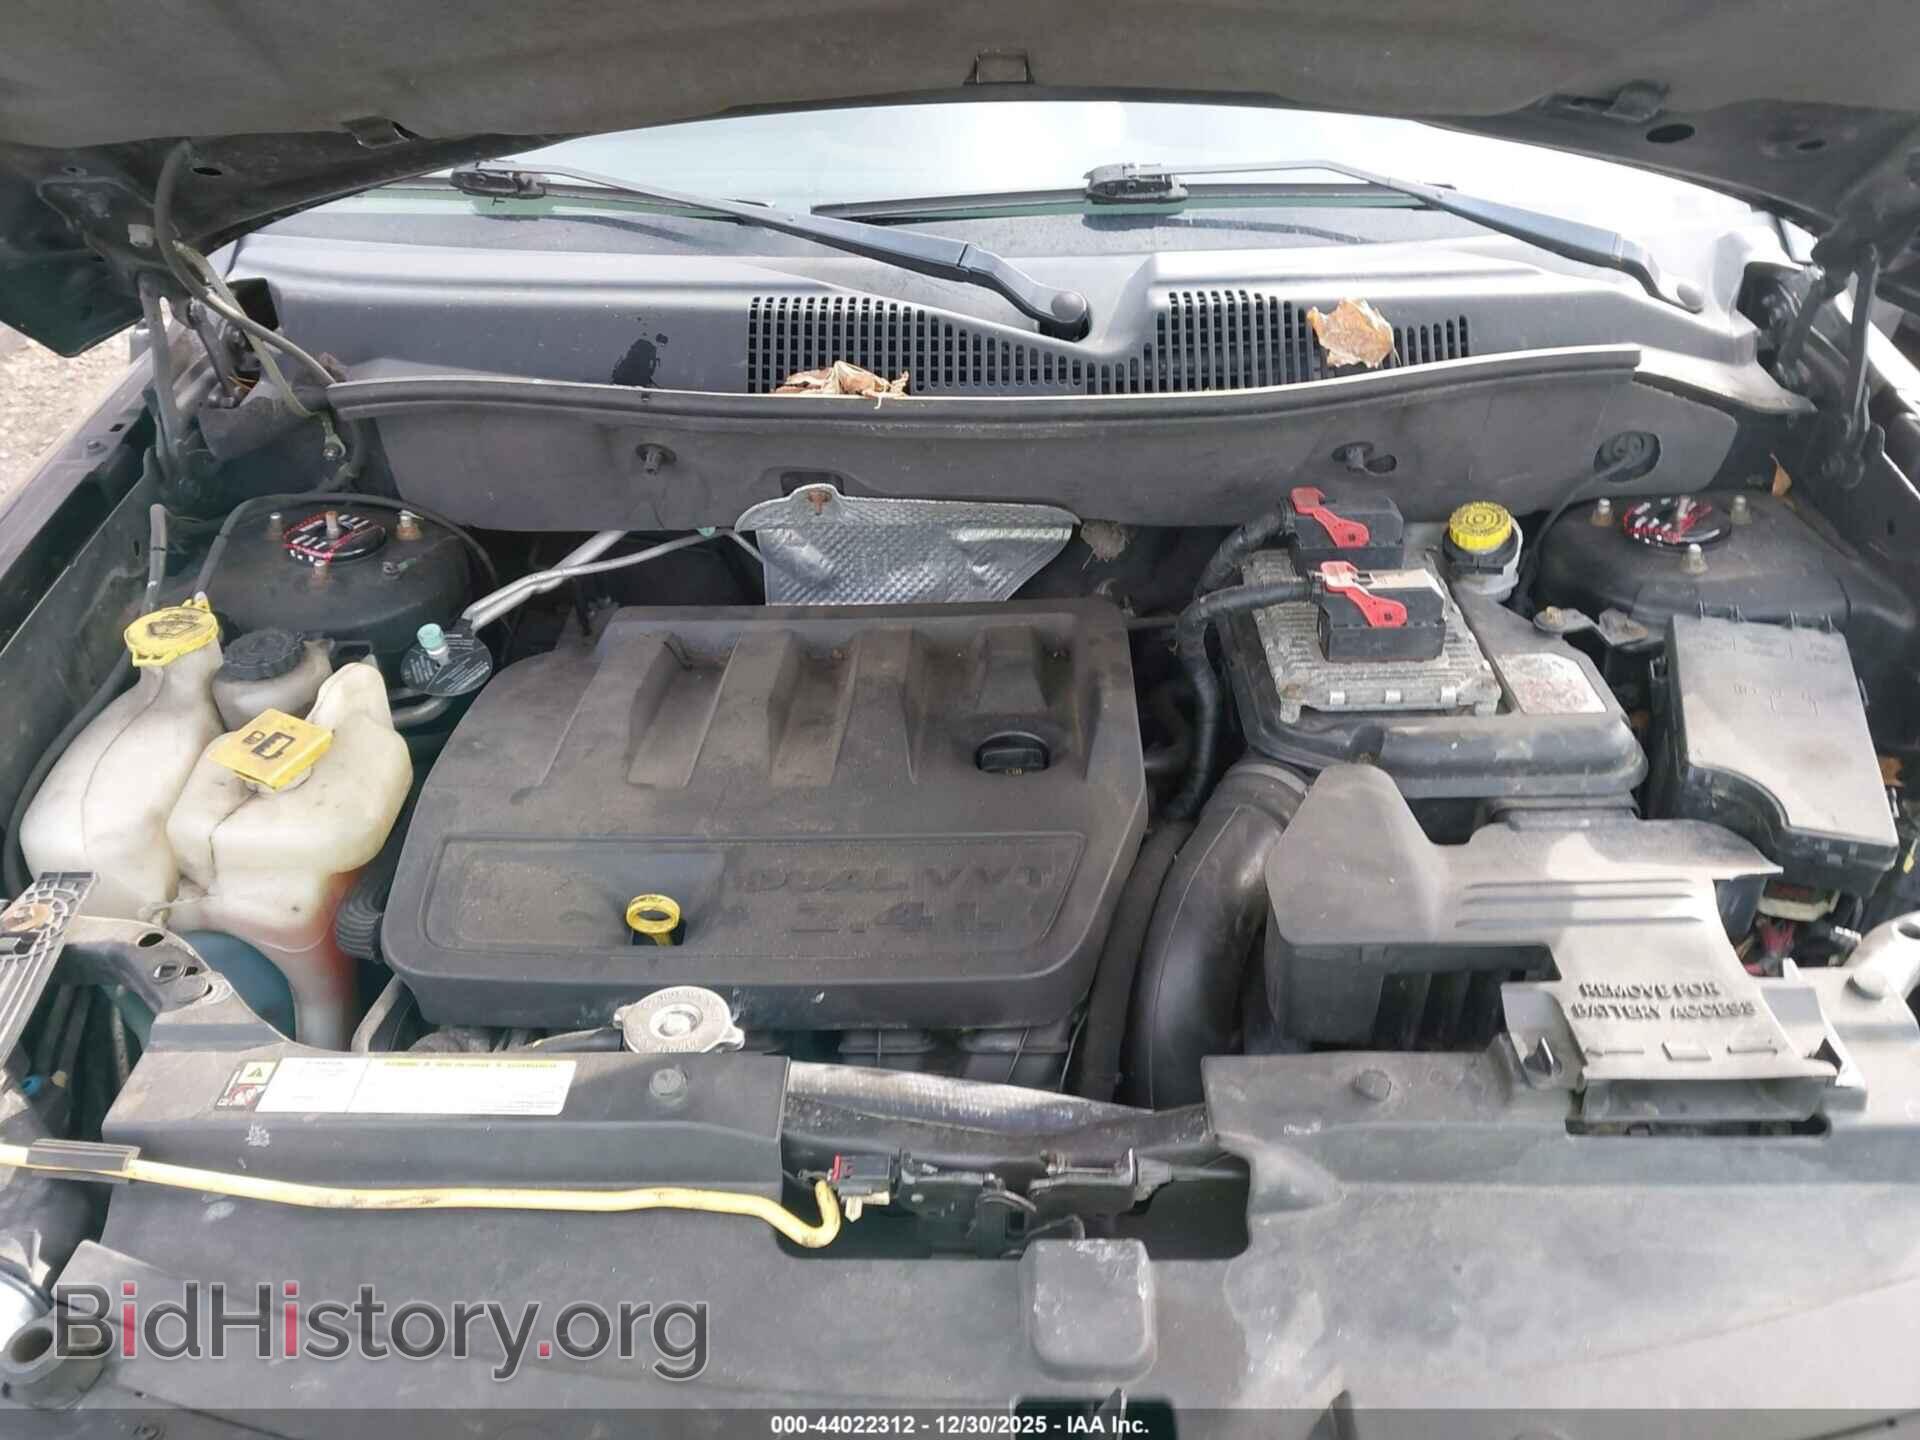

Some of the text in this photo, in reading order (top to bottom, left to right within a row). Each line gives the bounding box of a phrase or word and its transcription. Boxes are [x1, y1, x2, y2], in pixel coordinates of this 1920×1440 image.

[1578, 981, 1720, 999] REMOVE FOR
[1570, 1000, 1756, 1019] BATTERY ACCESS
